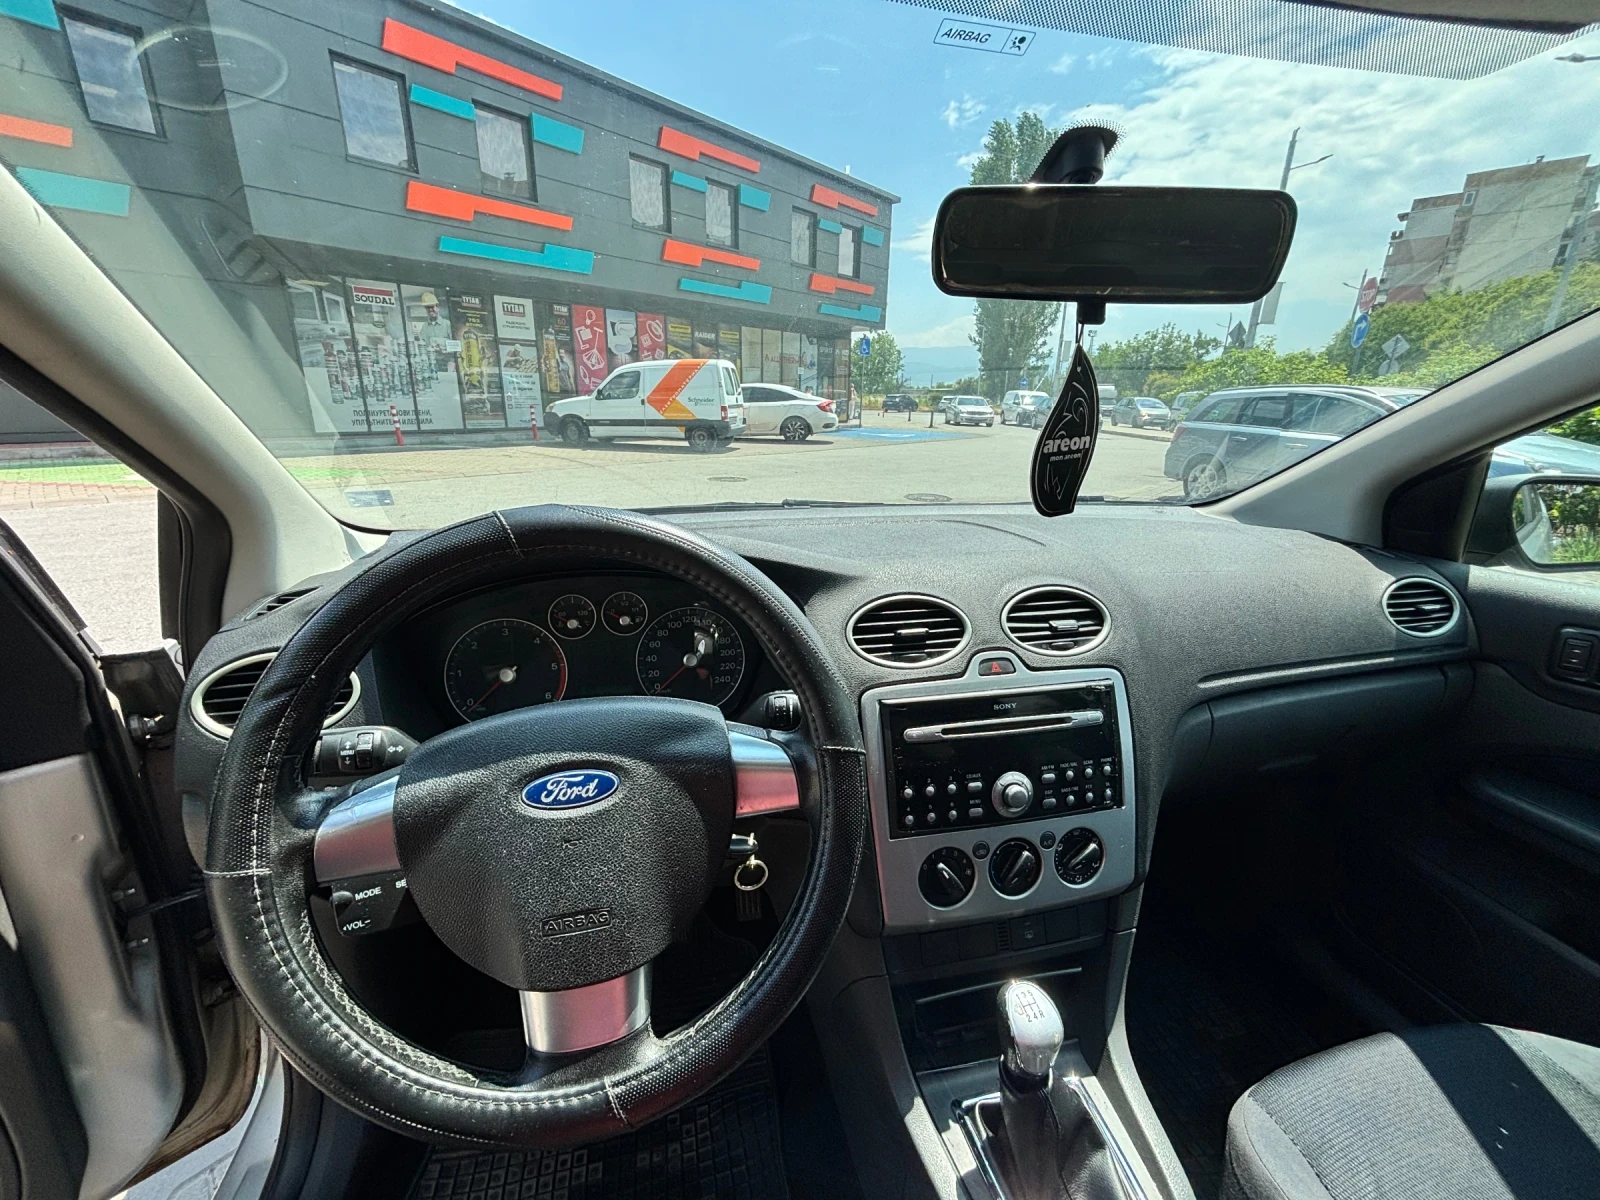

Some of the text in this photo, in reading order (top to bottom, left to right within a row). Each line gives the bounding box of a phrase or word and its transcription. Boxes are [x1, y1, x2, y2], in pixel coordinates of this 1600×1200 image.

[941, 28, 992, 44] AIRBAG
[354, 294, 394, 306] SOUDAL
[1361, 288, 1376, 302] STOP
[503, 303, 524, 313] TYTAN
[688, 397, 714, 406] Schneider
[1043, 436, 1090, 454] areon
[541, 776, 599, 802] Ford
[355, 886, 382, 900] MODE
[545, 912, 609, 932] AIRBAG
[1026, 1014, 1032, 1022] 2
[1039, 1010, 1045, 1018] R
